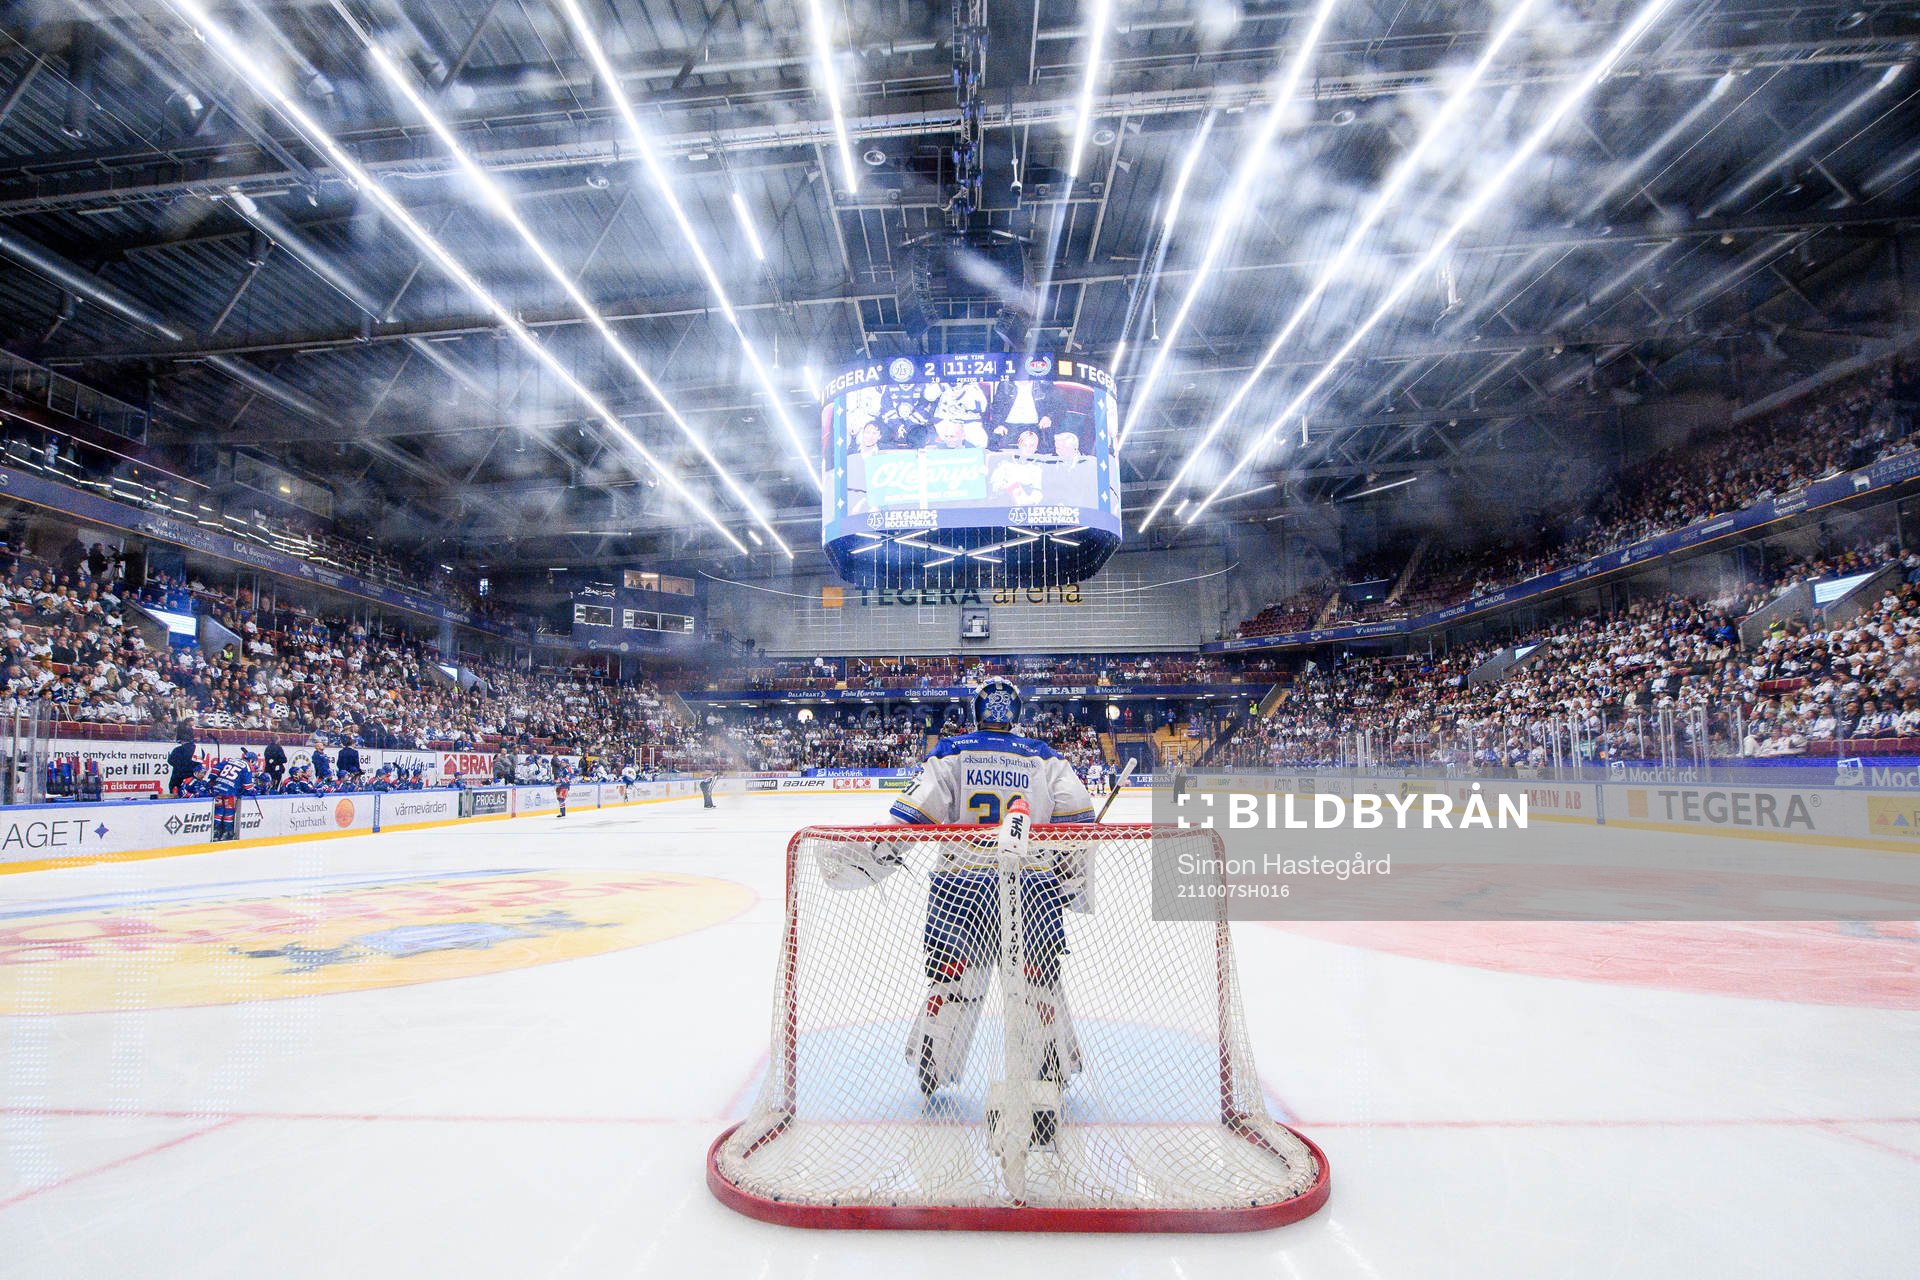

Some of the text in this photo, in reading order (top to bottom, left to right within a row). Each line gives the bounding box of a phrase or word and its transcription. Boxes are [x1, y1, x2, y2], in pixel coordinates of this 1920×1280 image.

[924, 360, 1016, 376] 2 11:24 1
[884, 510, 938, 520] LEKSANDS
[1028, 506, 1080, 517] LEKSANDS
[854, 584, 1083, 606] TEGERA arena
[1439, 605, 1467, 619] MATCHLOGE
[840, 690, 857, 698] Falu
[904, 688, 949, 697] clas ohlson
[1045, 687, 1080, 695] PEAB
[54, 750, 79, 761] mest
[82, 750, 127, 761] omtyckta
[130, 751, 171, 760] matvaru
[103, 763, 170, 779] pet till 23
[220, 764, 242, 780] 85
[111, 779, 137, 791] älskar
[140, 782, 156, 790] mat
[966, 769, 1029, 789] KASKISUO
[476, 793, 505, 806] PROGLAS
[1565, 791, 1582, 810] AB
[290, 800, 328, 814] Leksands
[394, 801, 447, 816] värmevärden
[184, 811, 211, 823] Lind
[289, 815, 327, 831] Sparbank
[1010, 814, 1024, 841] SHL
